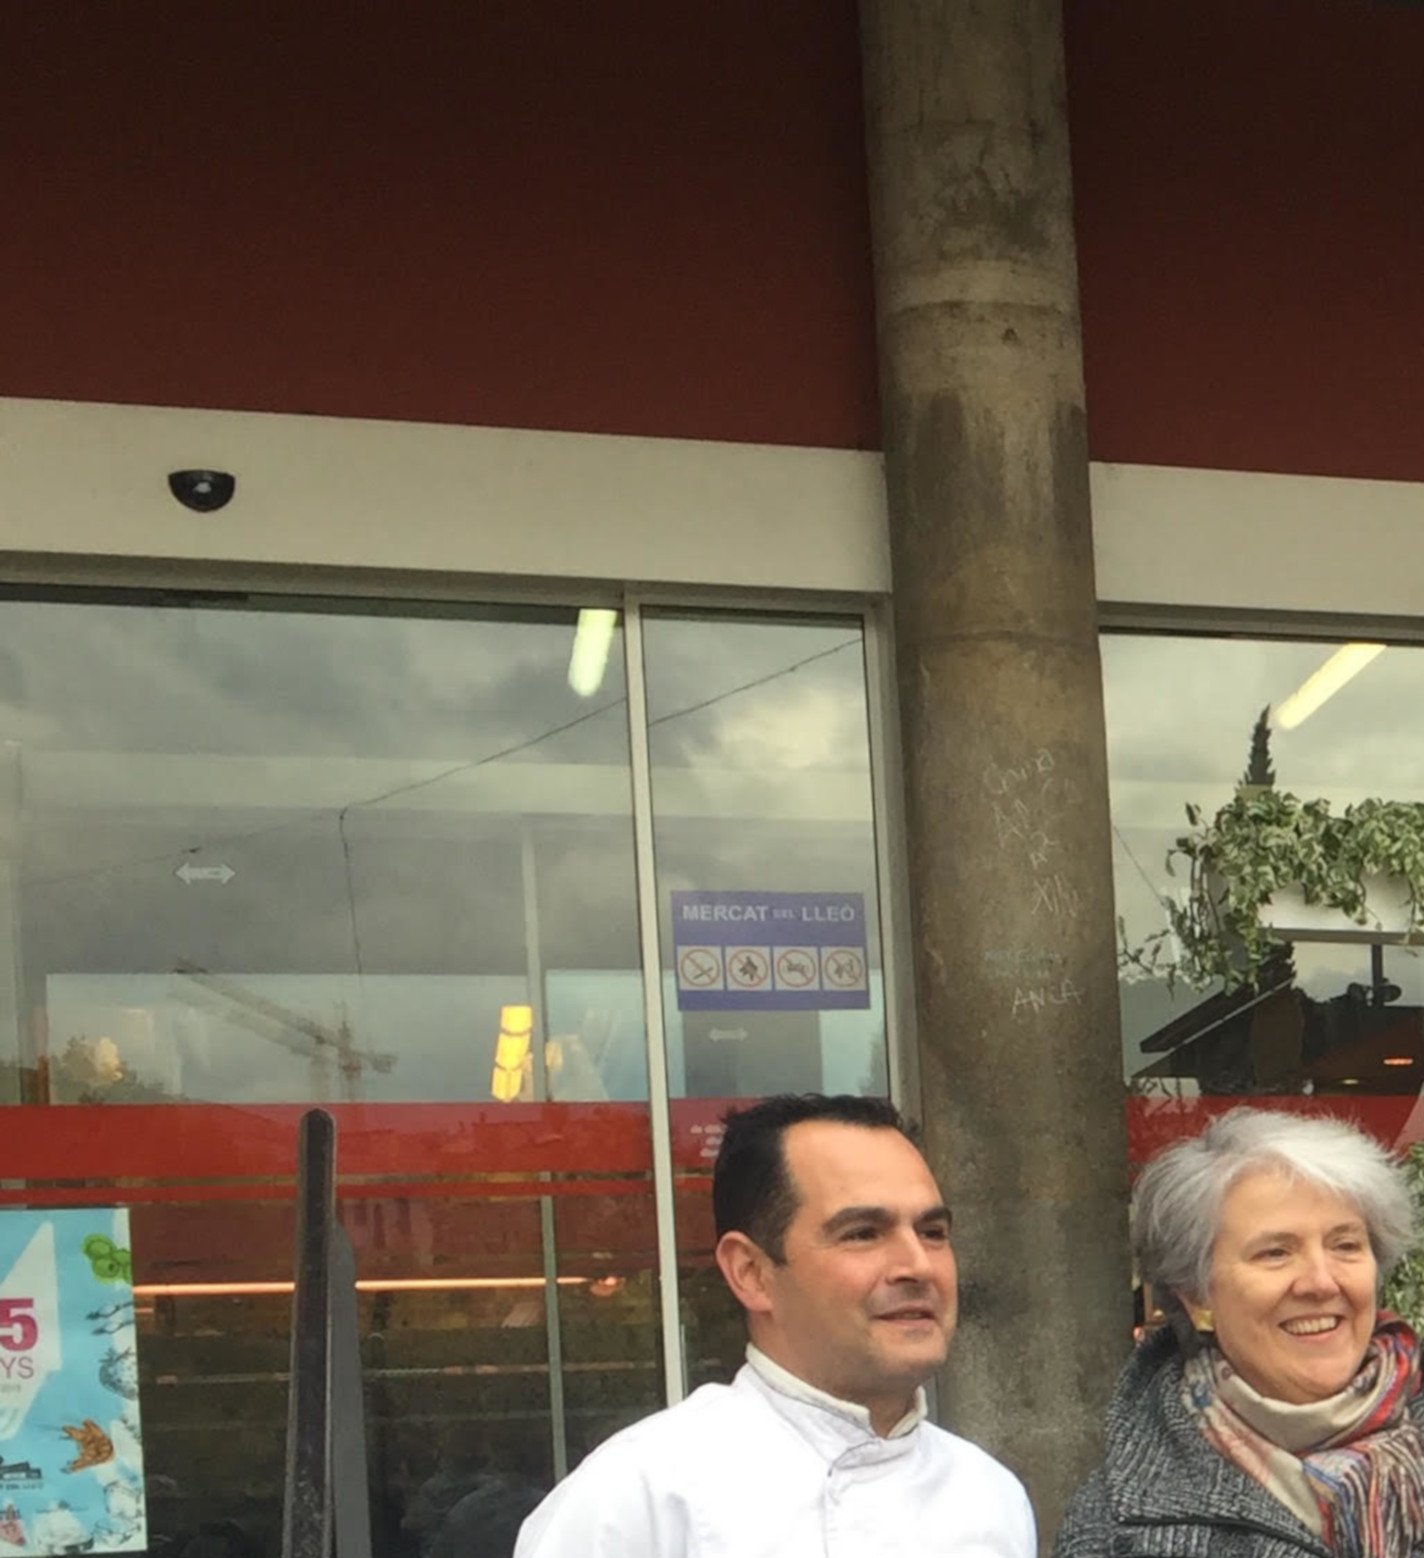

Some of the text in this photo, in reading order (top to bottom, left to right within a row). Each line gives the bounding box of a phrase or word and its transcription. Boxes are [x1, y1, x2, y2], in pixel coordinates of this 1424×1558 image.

[682, 905, 768, 922] MERCAT
[802, 903, 855, 923] LLEÓ
[0, 1297, 38, 1352] 5
[0, 1355, 34, 1380] YS
